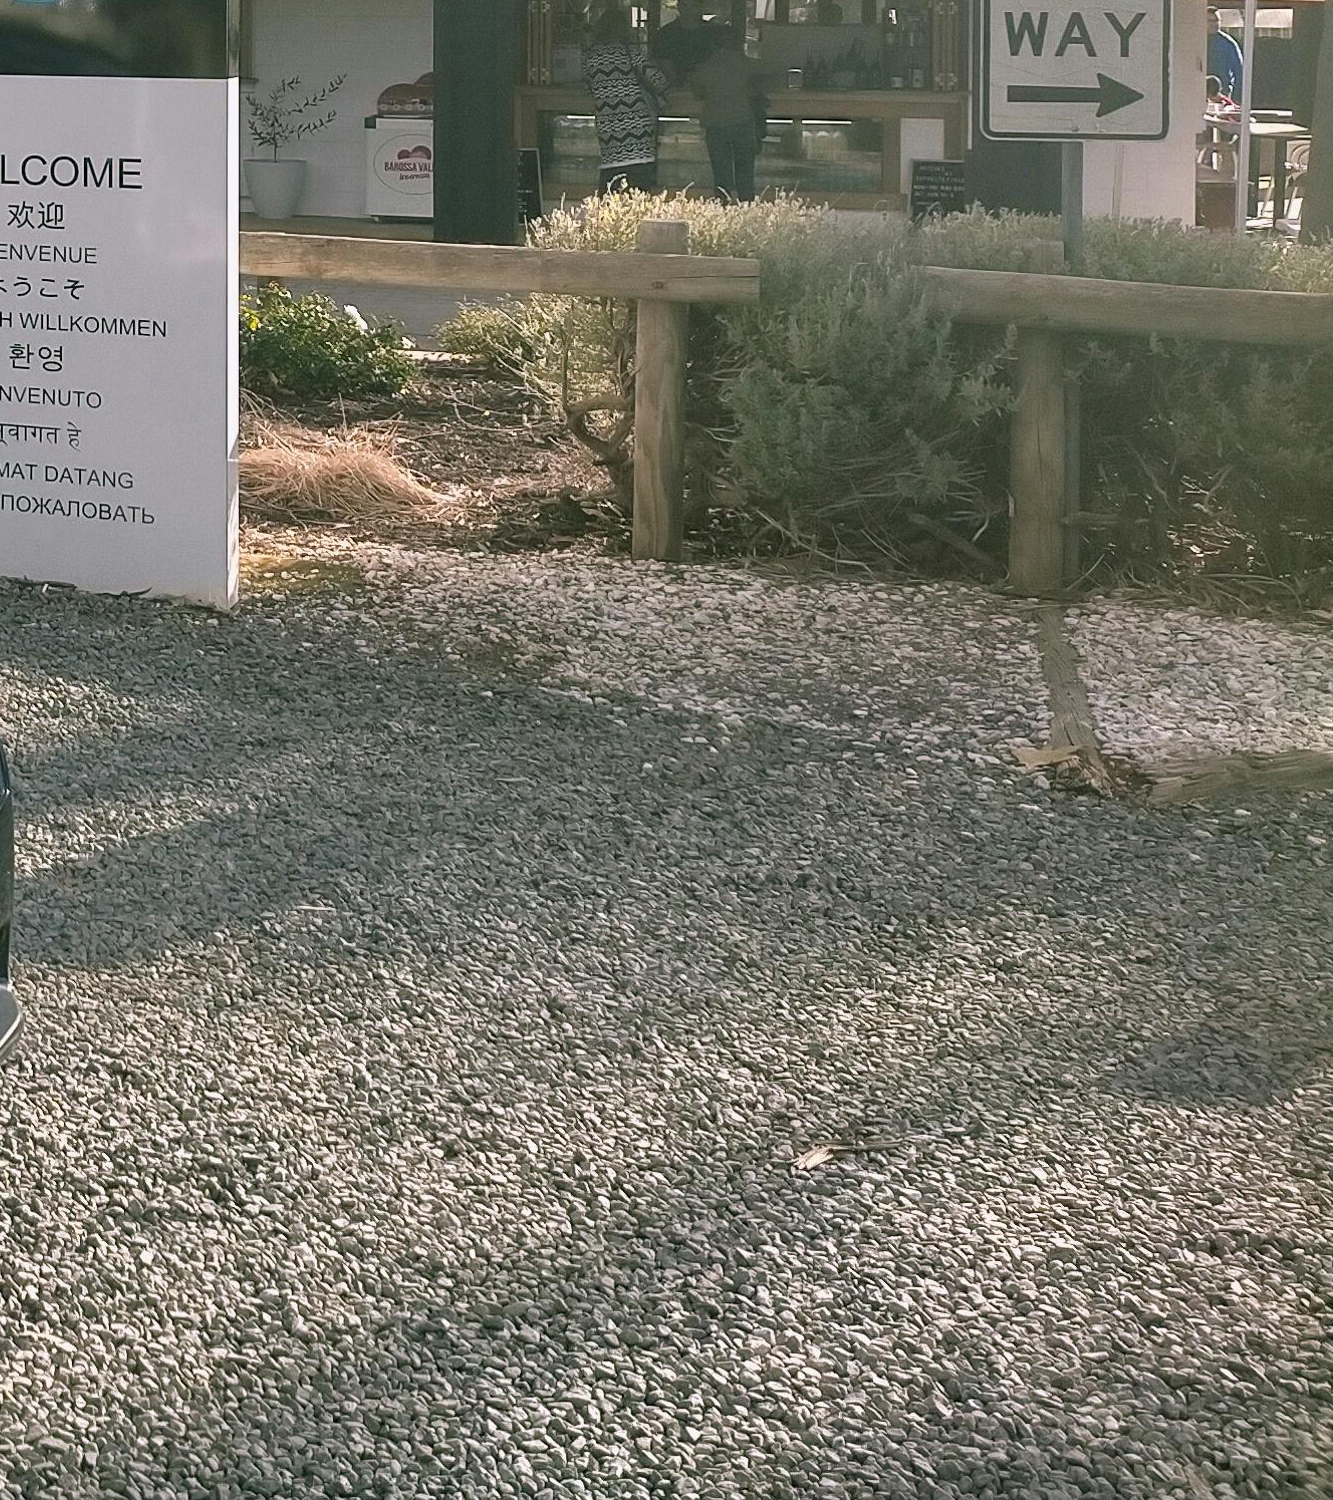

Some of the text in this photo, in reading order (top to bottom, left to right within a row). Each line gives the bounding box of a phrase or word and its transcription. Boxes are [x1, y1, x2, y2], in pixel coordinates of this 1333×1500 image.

[1004, 11, 1147, 58] WAY
[7, 200, 66, 230] 欢迎
[19, 312, 167, 337] WILLKOMMEN
[9, 343, 63, 372] 환영
[44, 466, 134, 489] DATANG
[1, 494, 155, 524] ПОЖАЛОВАТЬ
